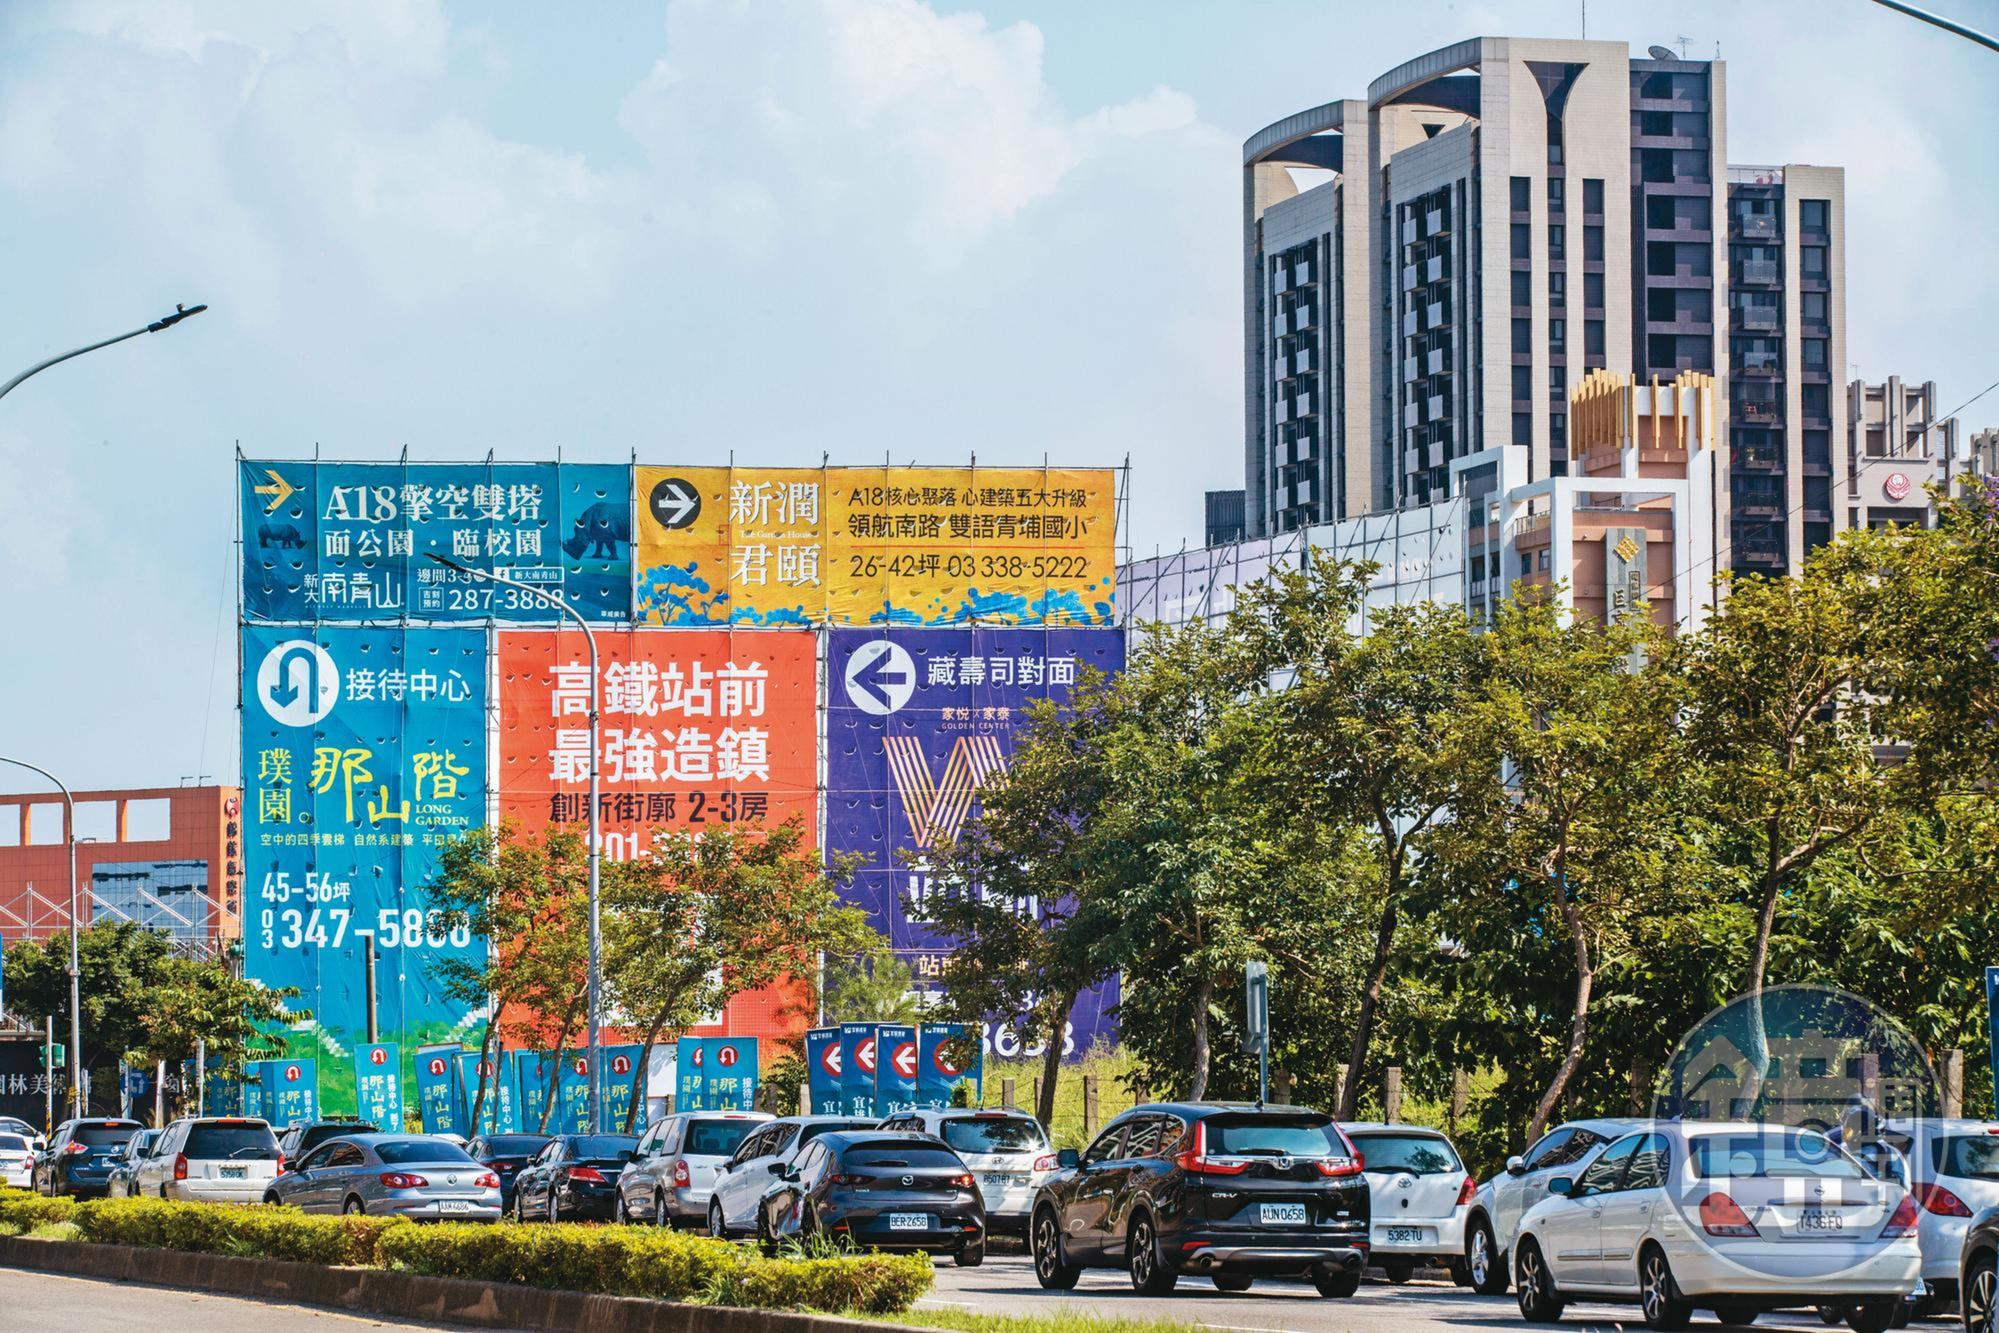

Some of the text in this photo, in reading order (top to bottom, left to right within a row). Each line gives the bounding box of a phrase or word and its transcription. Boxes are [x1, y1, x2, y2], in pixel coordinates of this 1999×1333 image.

[848, 514, 1087, 540] 領航南路 雙語青埔國小
[850, 554, 1087, 579] 26-42坪 03 338-5222
[346, 667, 472, 702] 接待中心
[927, 656, 1076, 686] 藏壽司對面
[549, 661, 769, 717] 高鐵站前
[549, 727, 770, 783] 最強造鎮
[415, 804, 452, 815] LONG
[415, 816, 469, 826] GARDEN
[550, 790, 769, 823] 創新街廓 2-3房
[261, 872, 350, 903] 45-56坪
